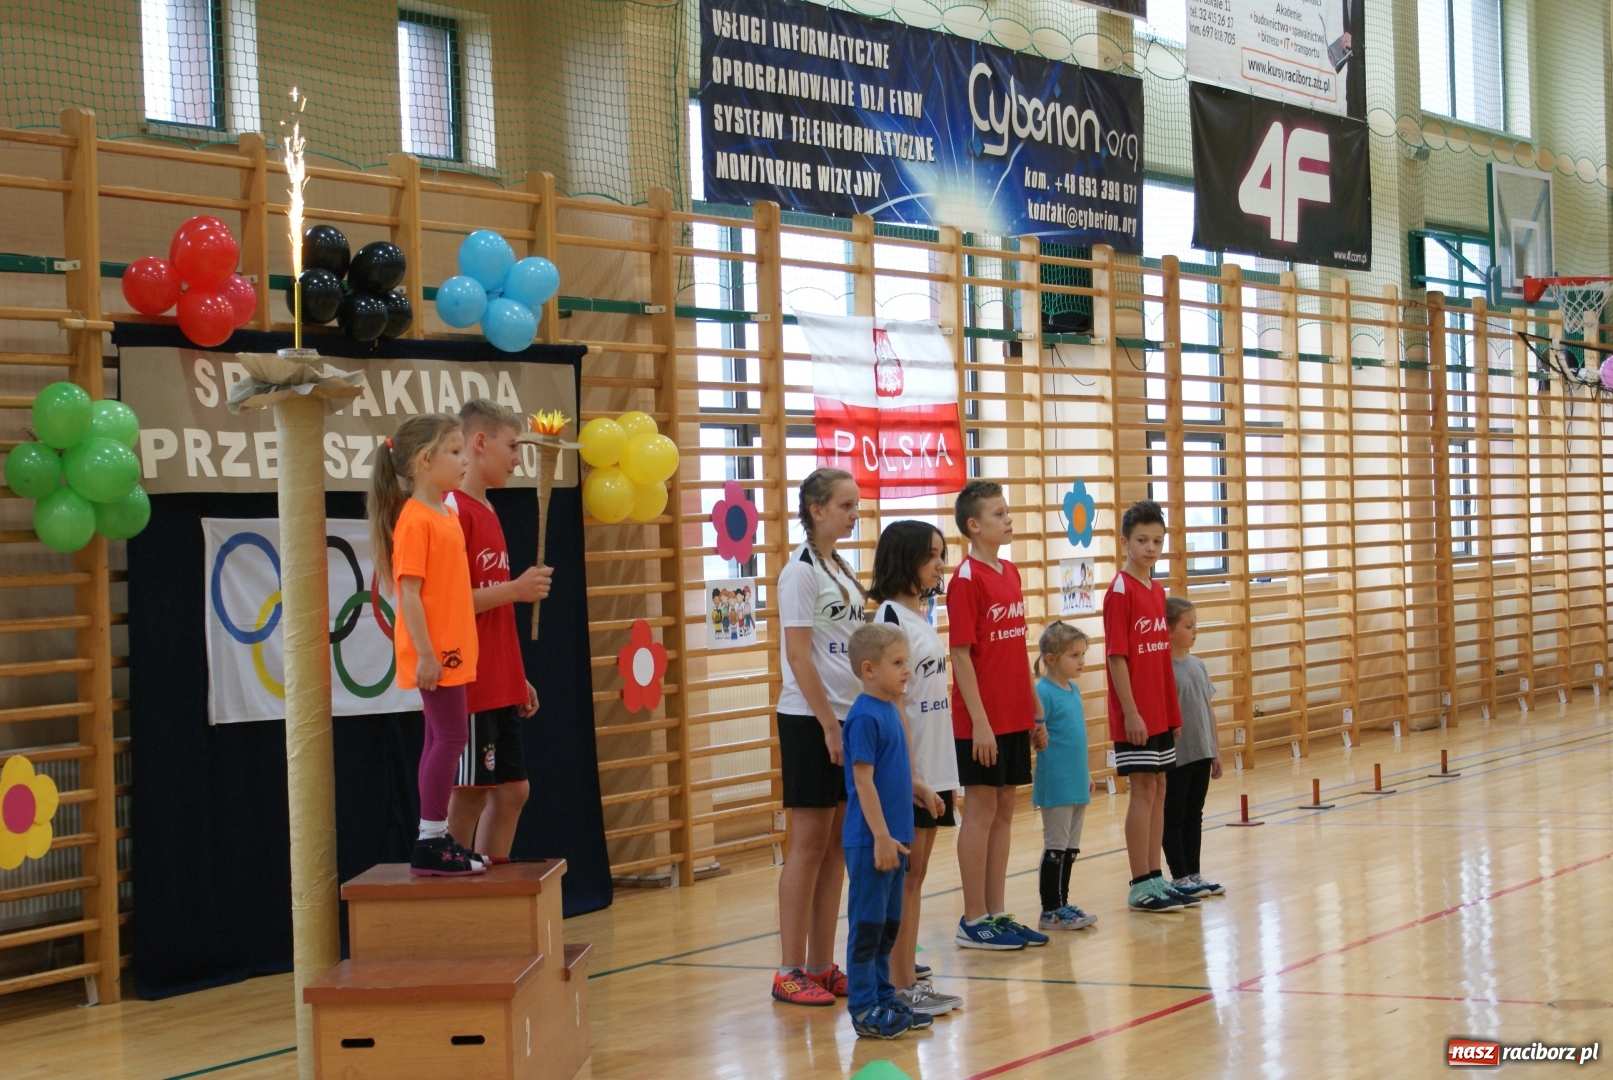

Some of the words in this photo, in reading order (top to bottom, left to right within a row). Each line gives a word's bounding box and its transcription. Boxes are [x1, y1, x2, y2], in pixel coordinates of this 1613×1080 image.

[1199, 7, 1207, 21] 32
[1218, 13, 1226, 27] 26
[1202, 25, 1214, 39] 697
[1224, 31, 1236, 45] 705
[1253, 11, 1289, 33] budownictwa
[712, 8, 767, 46] USŁUGI
[773, 21, 890, 70] INFORMATYCZNE
[1261, 29, 1280, 47] biznesu
[1283, 37, 1291, 50] IT
[1293, 41, 1320, 59] transportu
[712, 56, 855, 107] OPROGRAMOWANIE
[860, 83, 884, 113] DLA
[889, 89, 923, 119] FIRM
[713, 104, 784, 140] SYSTEMY
[791, 116, 936, 162] TELEINFORMATYCZNE
[716, 151, 812, 190] MONITORING
[817, 164, 882, 198] WIZYJNY
[1024, 166, 1050, 191] kom.
[1055, 173, 1076, 195] +48
[1078, 176, 1098, 198] 693
[1101, 179, 1120, 202] 399
[1123, 183, 1137, 205] 671
[1238, 121, 1331, 243] 4F
[1027, 198, 1137, 238] kontakt@cyberion.org
[834, 430, 953, 472] POLSKA
